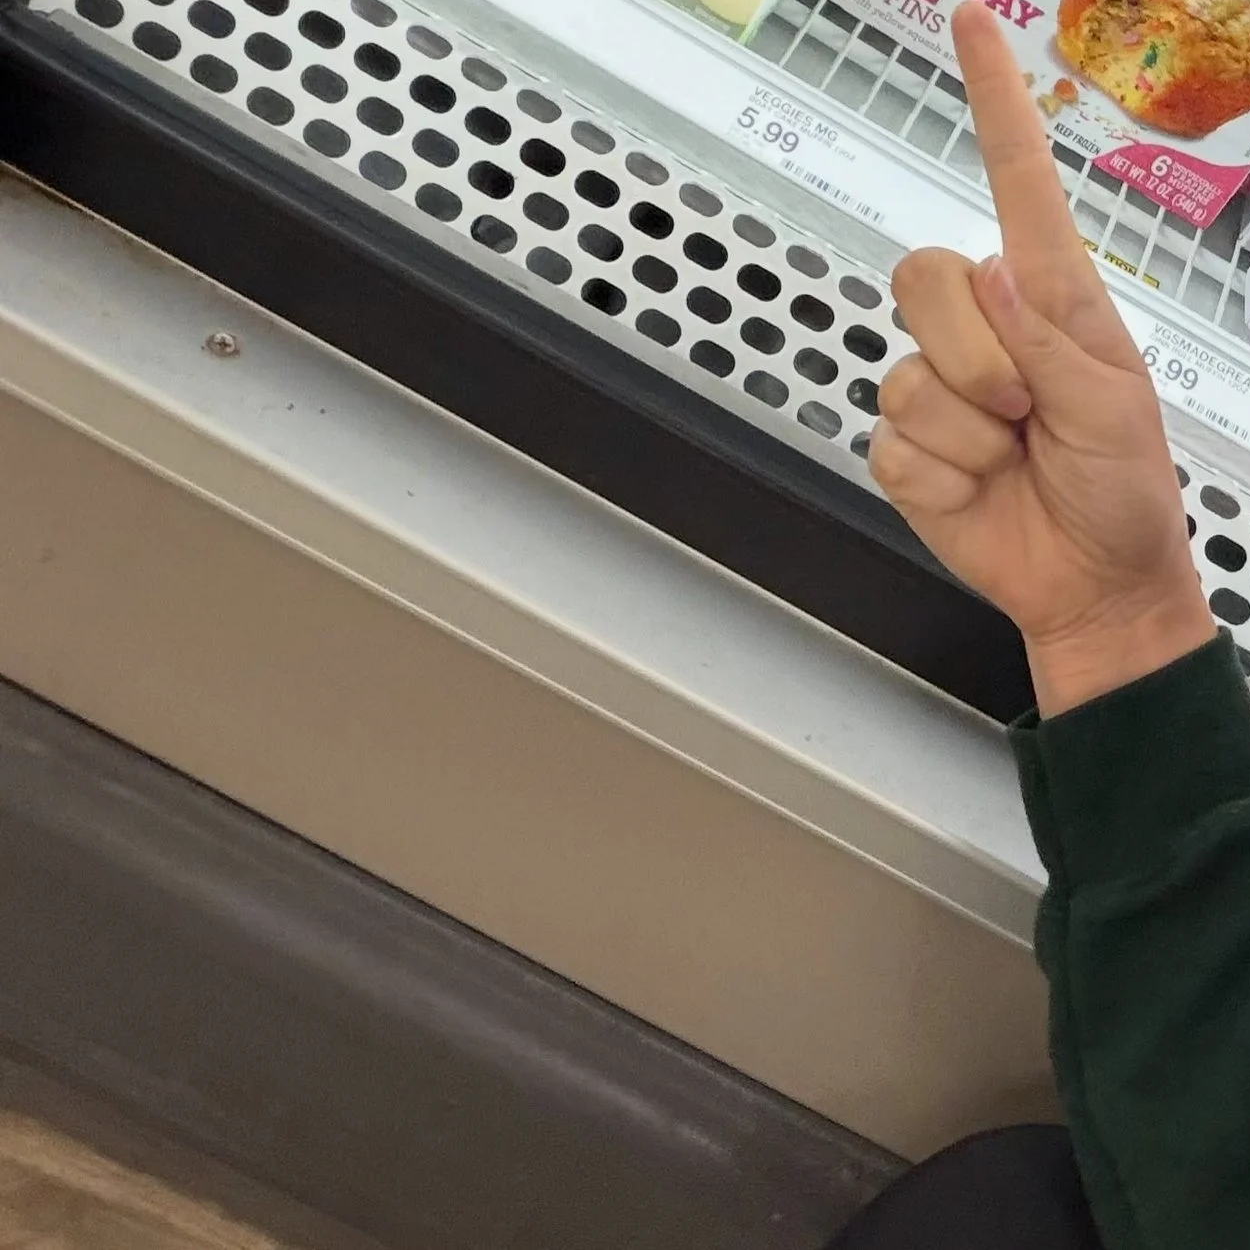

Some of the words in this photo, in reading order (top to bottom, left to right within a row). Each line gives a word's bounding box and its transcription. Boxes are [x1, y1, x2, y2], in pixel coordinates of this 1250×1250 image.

[736, 105, 800, 154] 5.99
[754, 86, 814, 127] VEGGIES
[814, 122, 839, 142] MG
[1054, 122, 1074, 138] KEEP
[1072, 133, 1101, 156] FROZEN
[1109, 153, 1131, 173] NET
[1127, 164, 1147, 184] WT.
[1145, 175, 1160, 191] 12
[1171, 192, 1196, 214] (340
[1191, 207, 1207, 222] g)
[1149, 154, 1173, 177] 6
[1137, 344, 1200, 391] 6.99
